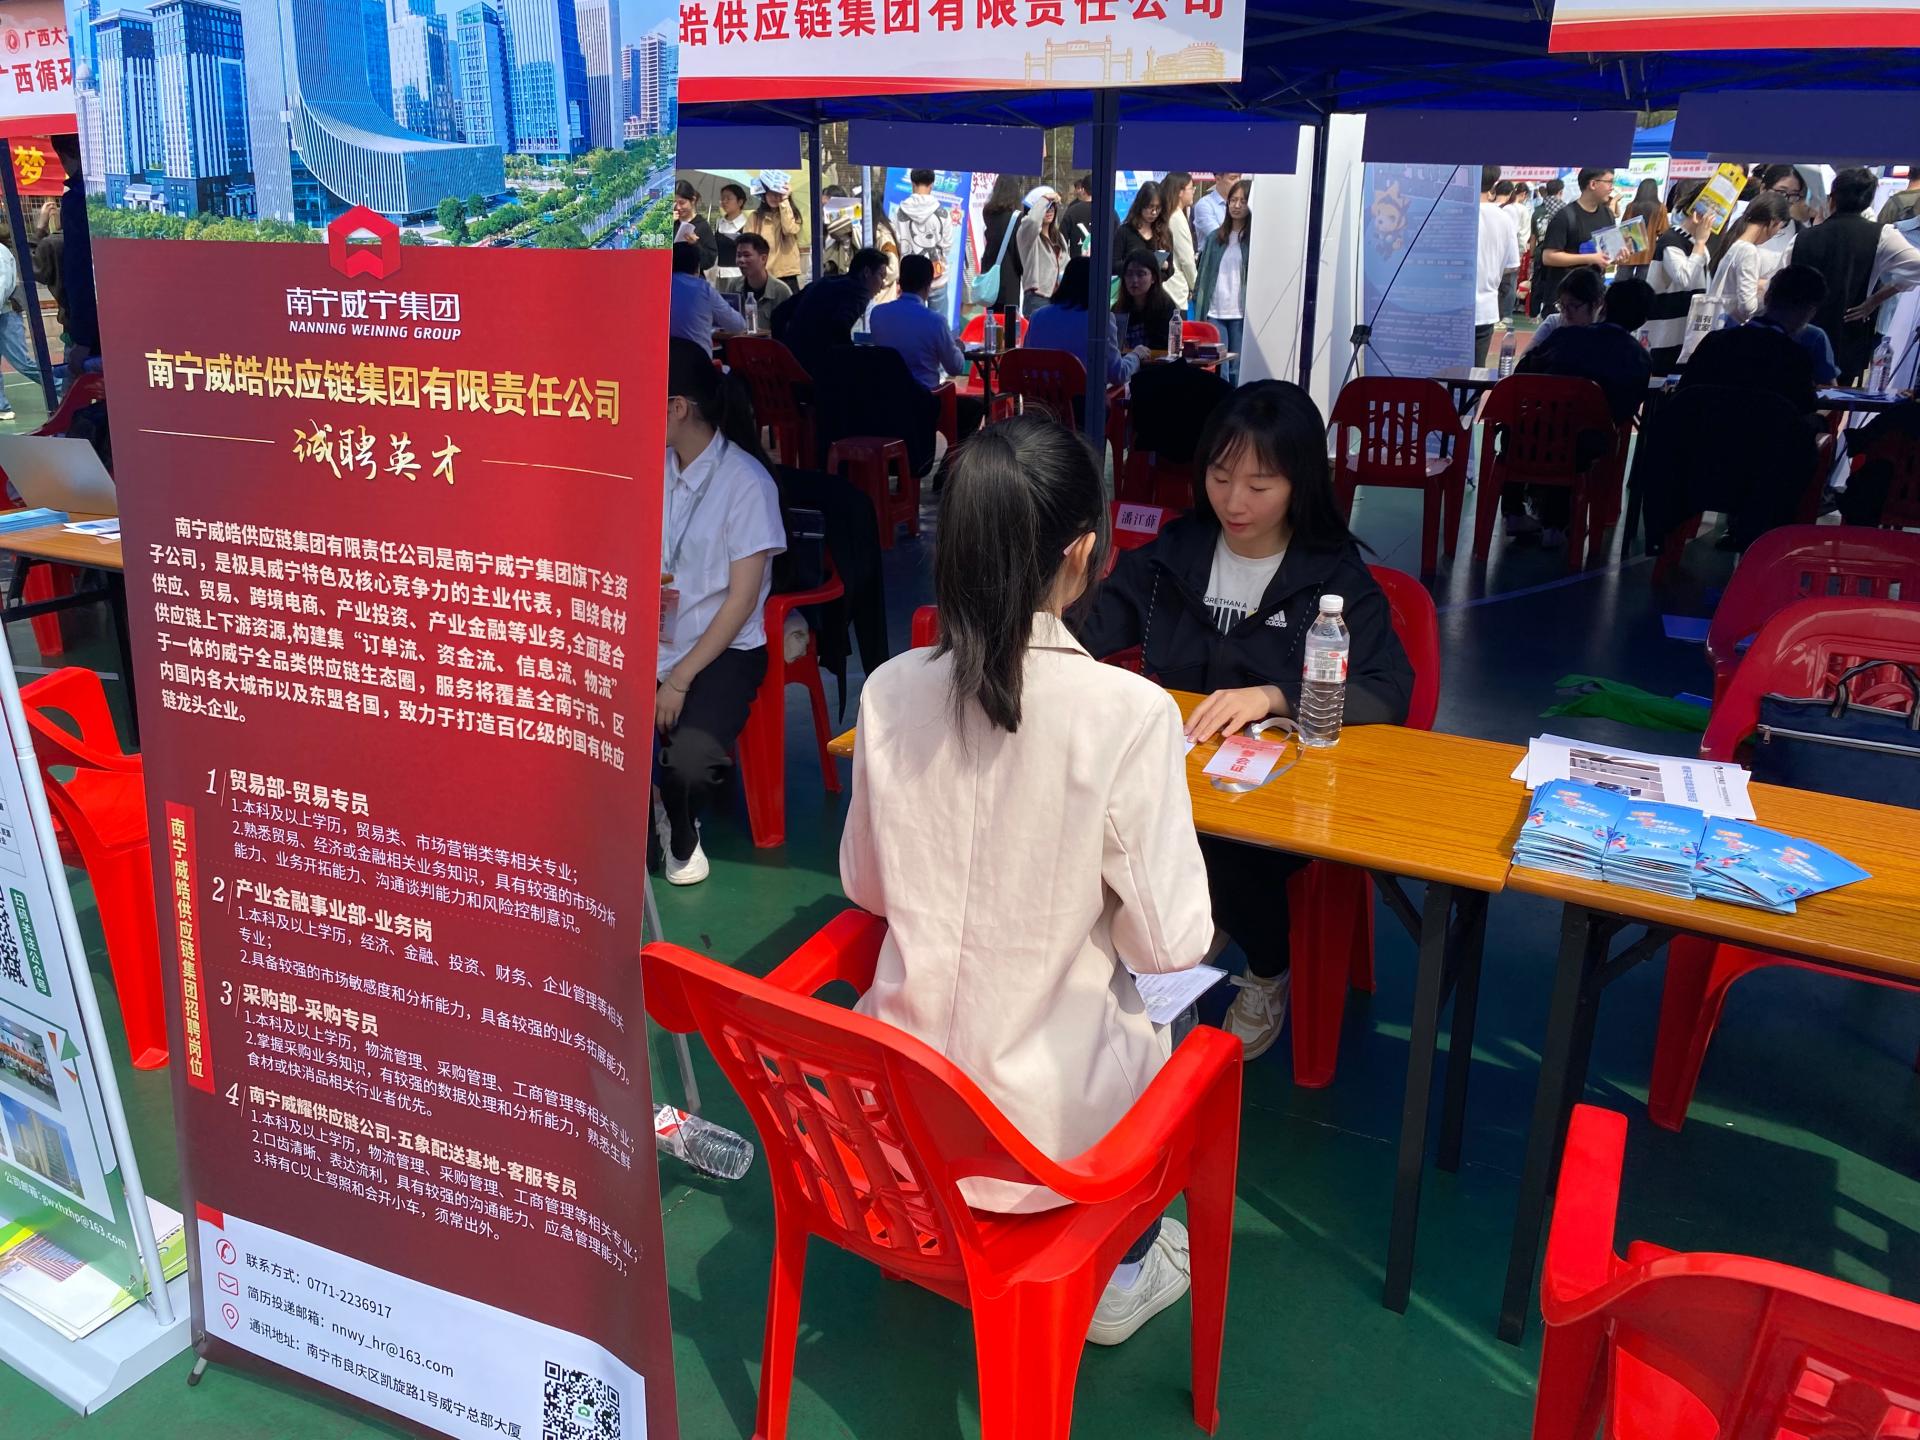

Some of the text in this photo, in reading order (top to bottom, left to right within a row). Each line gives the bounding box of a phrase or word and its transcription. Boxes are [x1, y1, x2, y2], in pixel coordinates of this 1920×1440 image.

[25, 26, 68, 48] 广西大
[14, 145, 46, 186] 梦
[286, 287, 461, 323] 南宁威宁集团
[289, 320, 461, 341] NANNING WEINING GROUP
[144, 348, 621, 425] 南宁威皓供应链集团有限责任公司
[293, 419, 462, 485] 诚聘英才
[175, 517, 628, 600] 南宁威皓供应链集团有限责任公司是南宁威宁集团旗下全资
[149, 543, 627, 636] 子公司，是极具威宁特色及核心竞争力的主业代表，围绕食材
[1219, 598, 1240, 609] THAN
[1264, 619, 1288, 628] adidas
[157, 631, 625, 738] 于一体的威宁全品类供应链生态圈，服务将覆盖全南宁市、区
[161, 688, 247, 723] 链龙头企业。
[159, 660, 625, 772] 内国内各大城市以及东盟各国，致力于打造百亿级的国有供应
[205, 768, 217, 794] 1
[230, 769, 369, 817] 贸易部-贸易专员
[212, 876, 225, 902] 2
[236, 879, 433, 942] 产业金融事业部-业务岗
[170, 818, 204, 1078] 南宁威皓供应链集团招聘岗位
[220, 981, 233, 1006] 3
[243, 983, 378, 1037] 采购部-采购专员
[225, 1082, 240, 1107] 4
[247, 1051, 433, 1117] 食材或快消品相关行业者优先。
[249, 1086, 578, 1200] 南宁威耀供应链公司-五象配送基地-客服专员
[253, 1150, 501, 1241] 3.持有C以上驾照和会开小车，须常出外。
